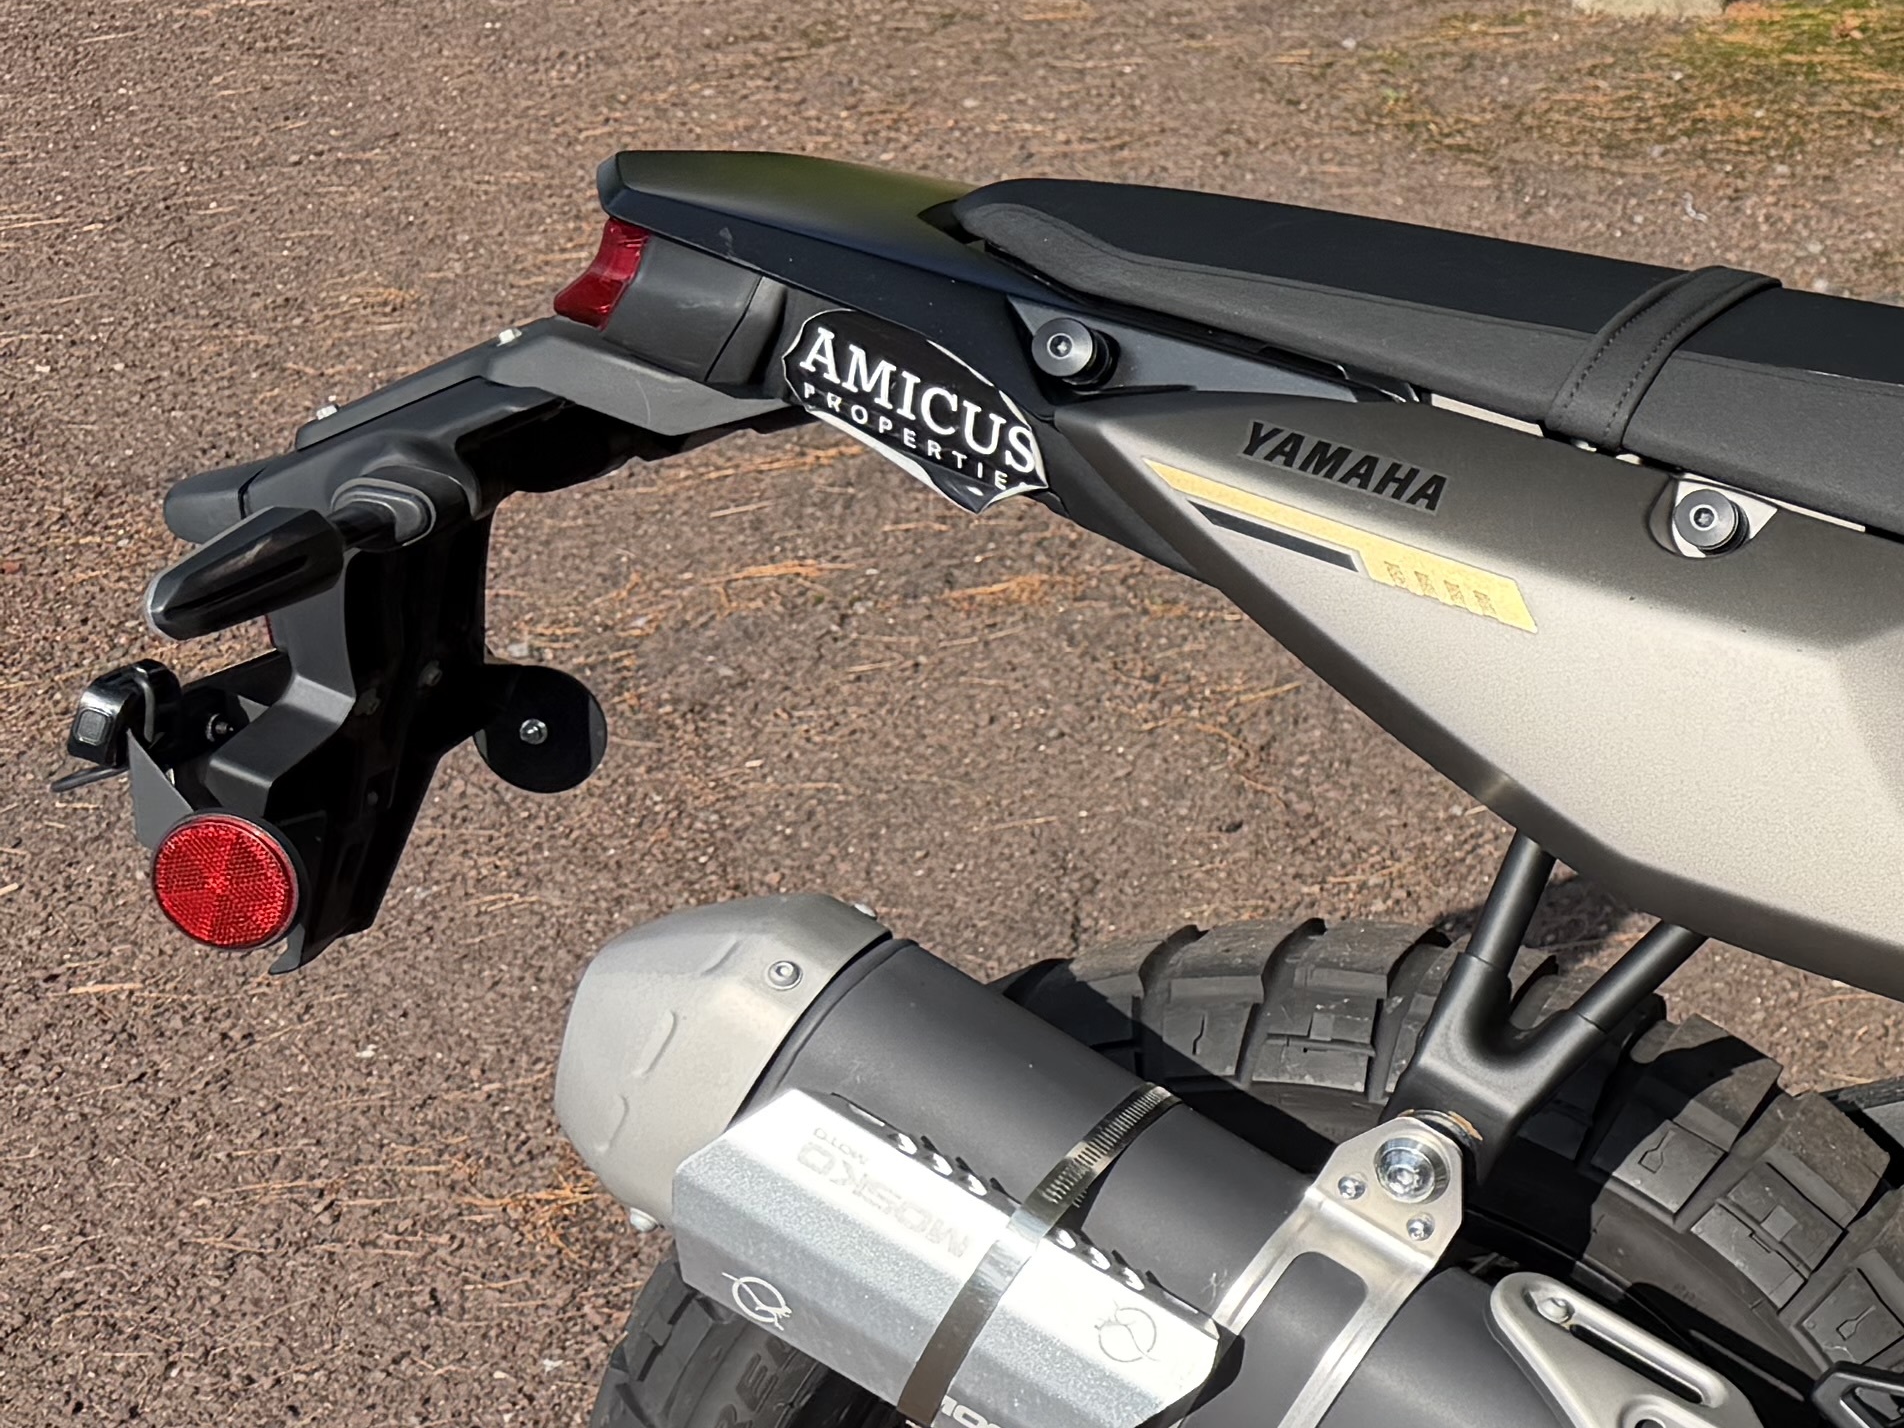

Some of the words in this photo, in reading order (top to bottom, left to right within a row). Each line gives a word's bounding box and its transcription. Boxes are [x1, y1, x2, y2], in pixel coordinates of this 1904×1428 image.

[799, 327, 1037, 473] AMICUS
[804, 382, 1034, 491] PROPERTIE
[1242, 421, 1449, 512] YAMAHA
